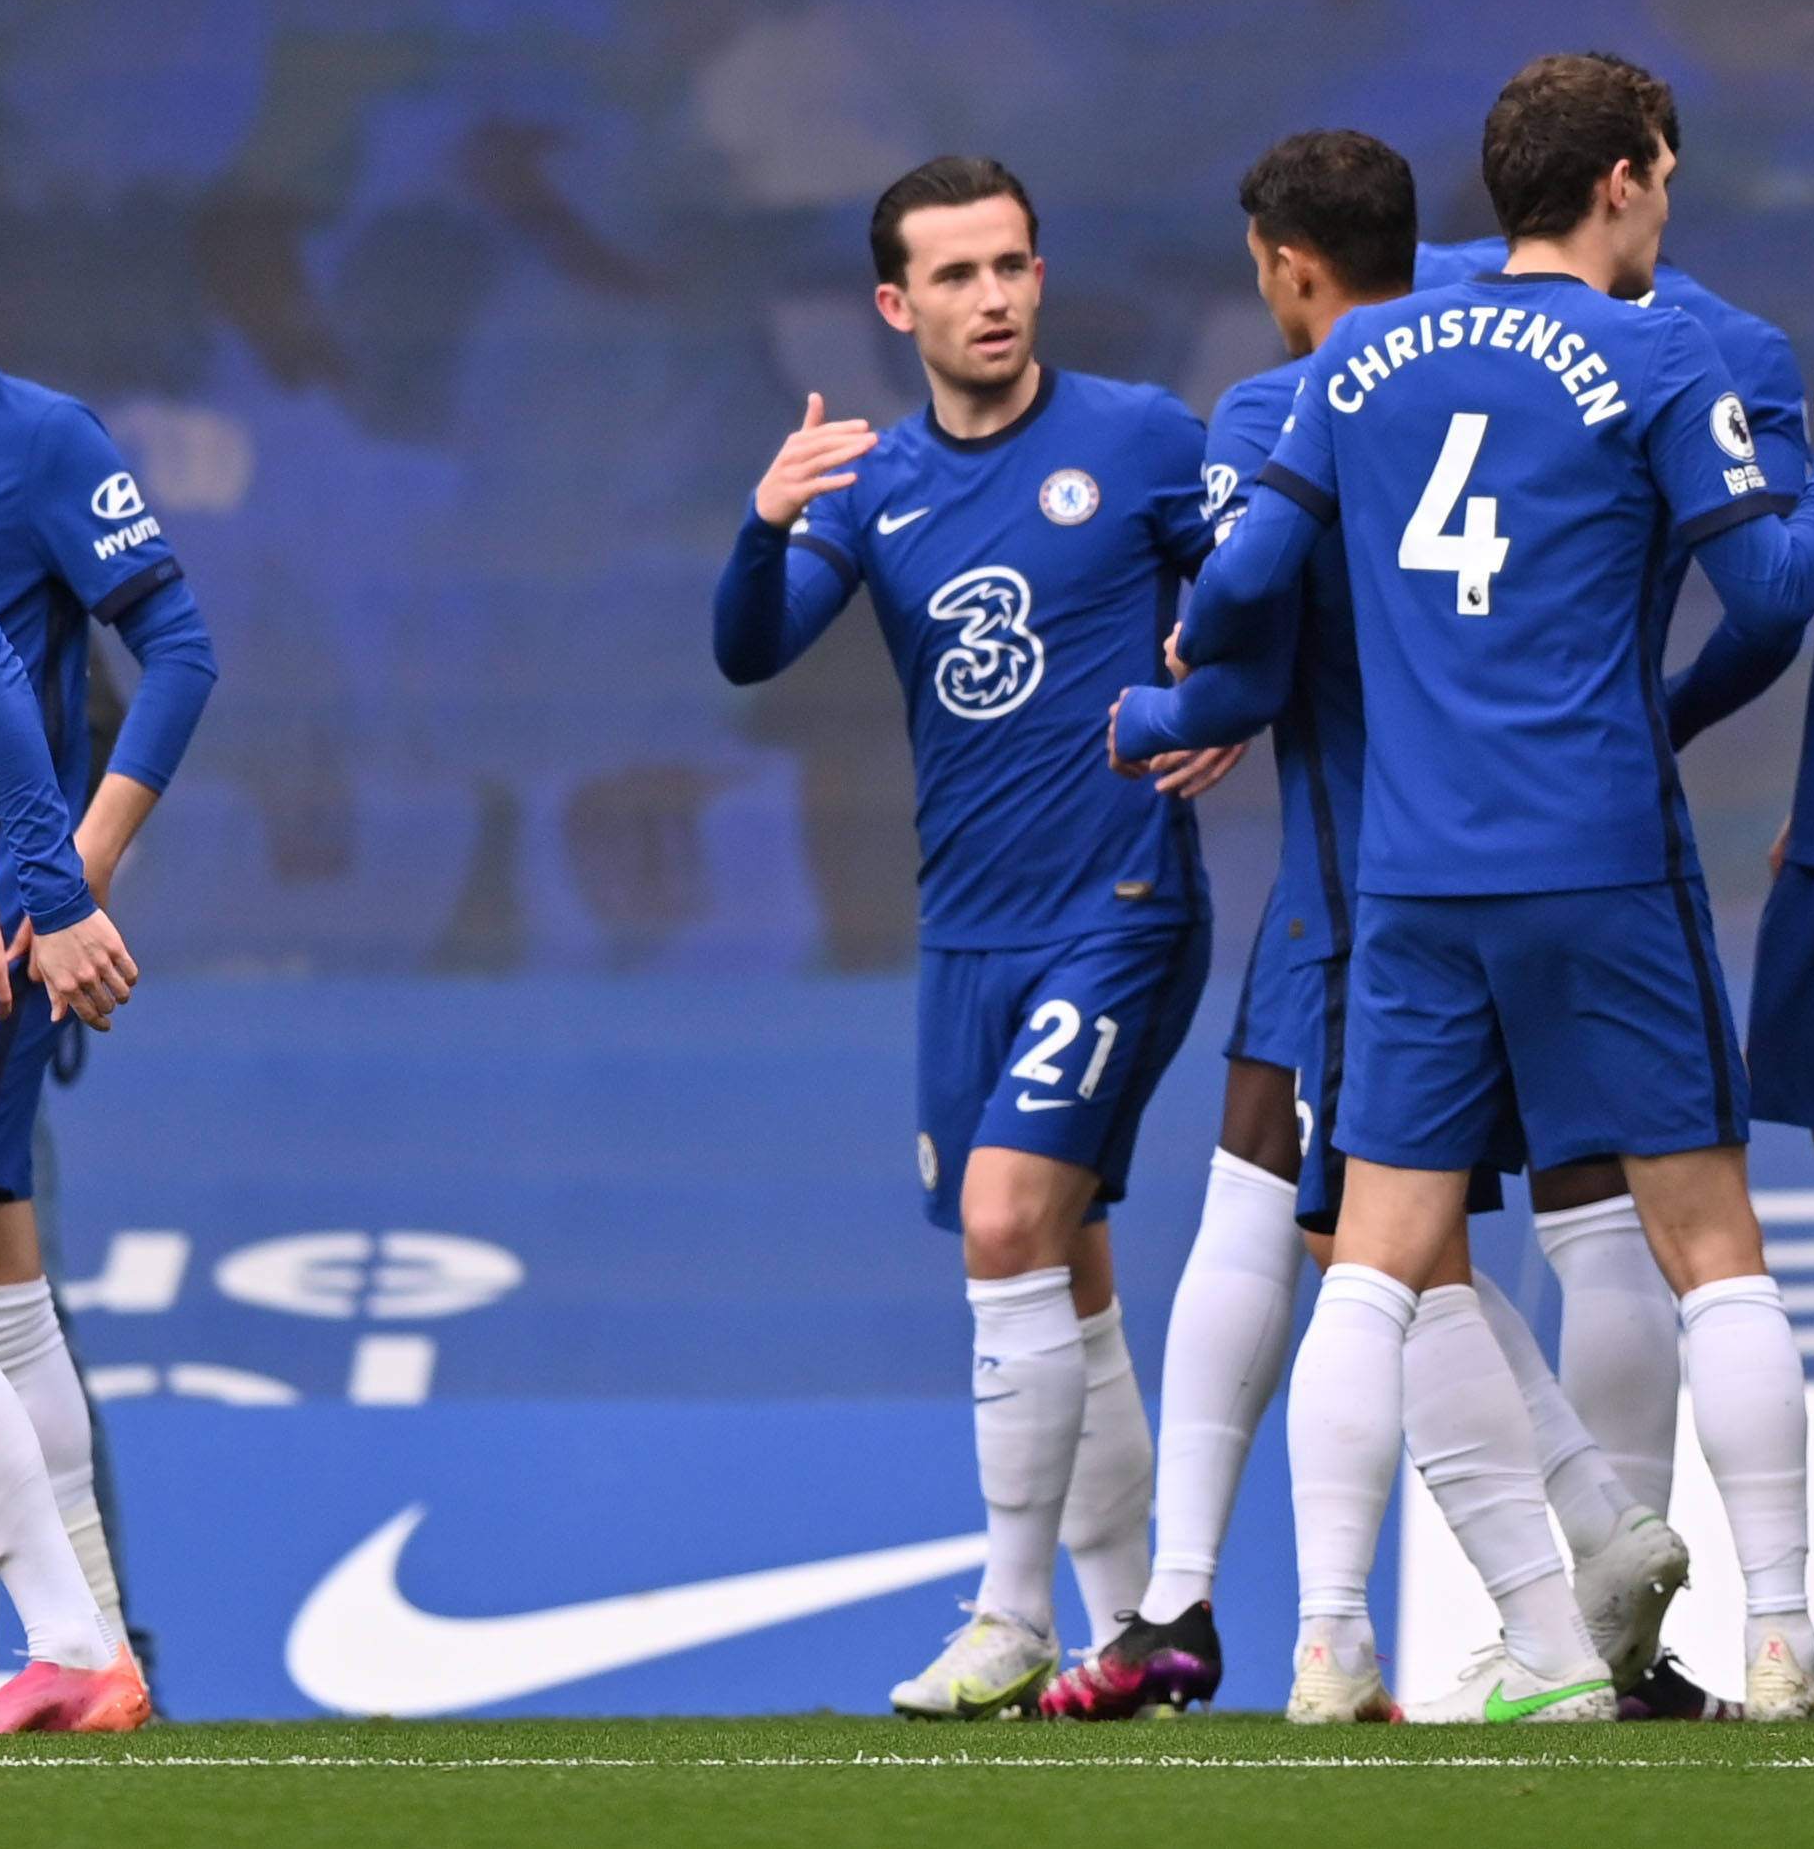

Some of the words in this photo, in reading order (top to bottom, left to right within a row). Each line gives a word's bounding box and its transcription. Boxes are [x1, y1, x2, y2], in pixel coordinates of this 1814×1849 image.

[1327, 306, 1626, 427] CHRISTENSEN
[1398, 412, 1511, 616] 4
[1010, 998, 1118, 1100] 21
